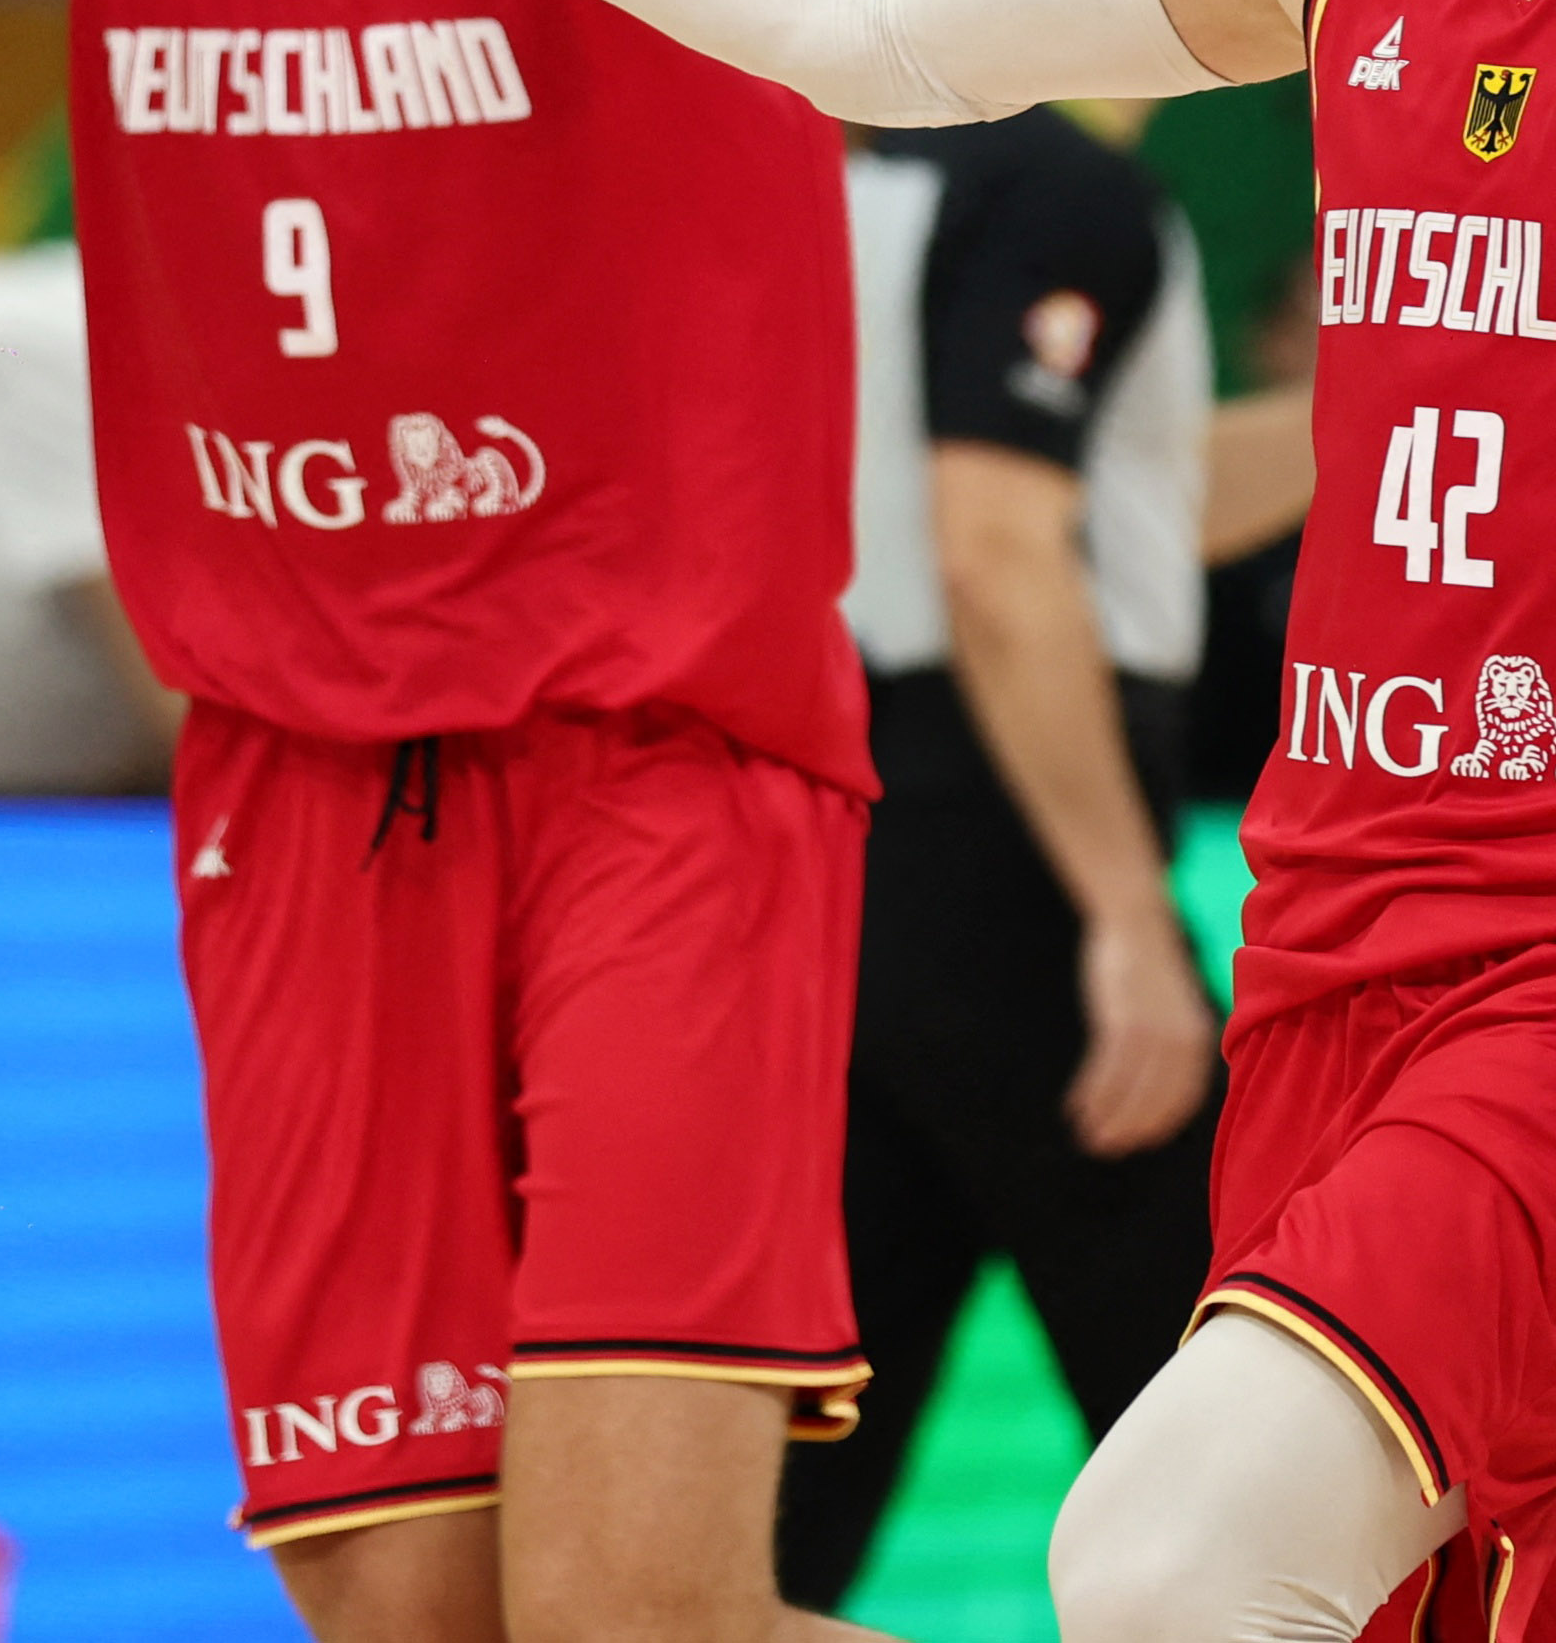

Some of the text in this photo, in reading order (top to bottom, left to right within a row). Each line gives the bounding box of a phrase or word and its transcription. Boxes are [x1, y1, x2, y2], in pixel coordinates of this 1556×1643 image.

[1347, 55, 1410, 91] PEAK
[263, 198, 338, 357] 9
[185, 422, 368, 530] ING
[1373, 406, 1505, 588] 42
[1286, 661, 1448, 778] ING
[243, 1385, 403, 1467] ING
